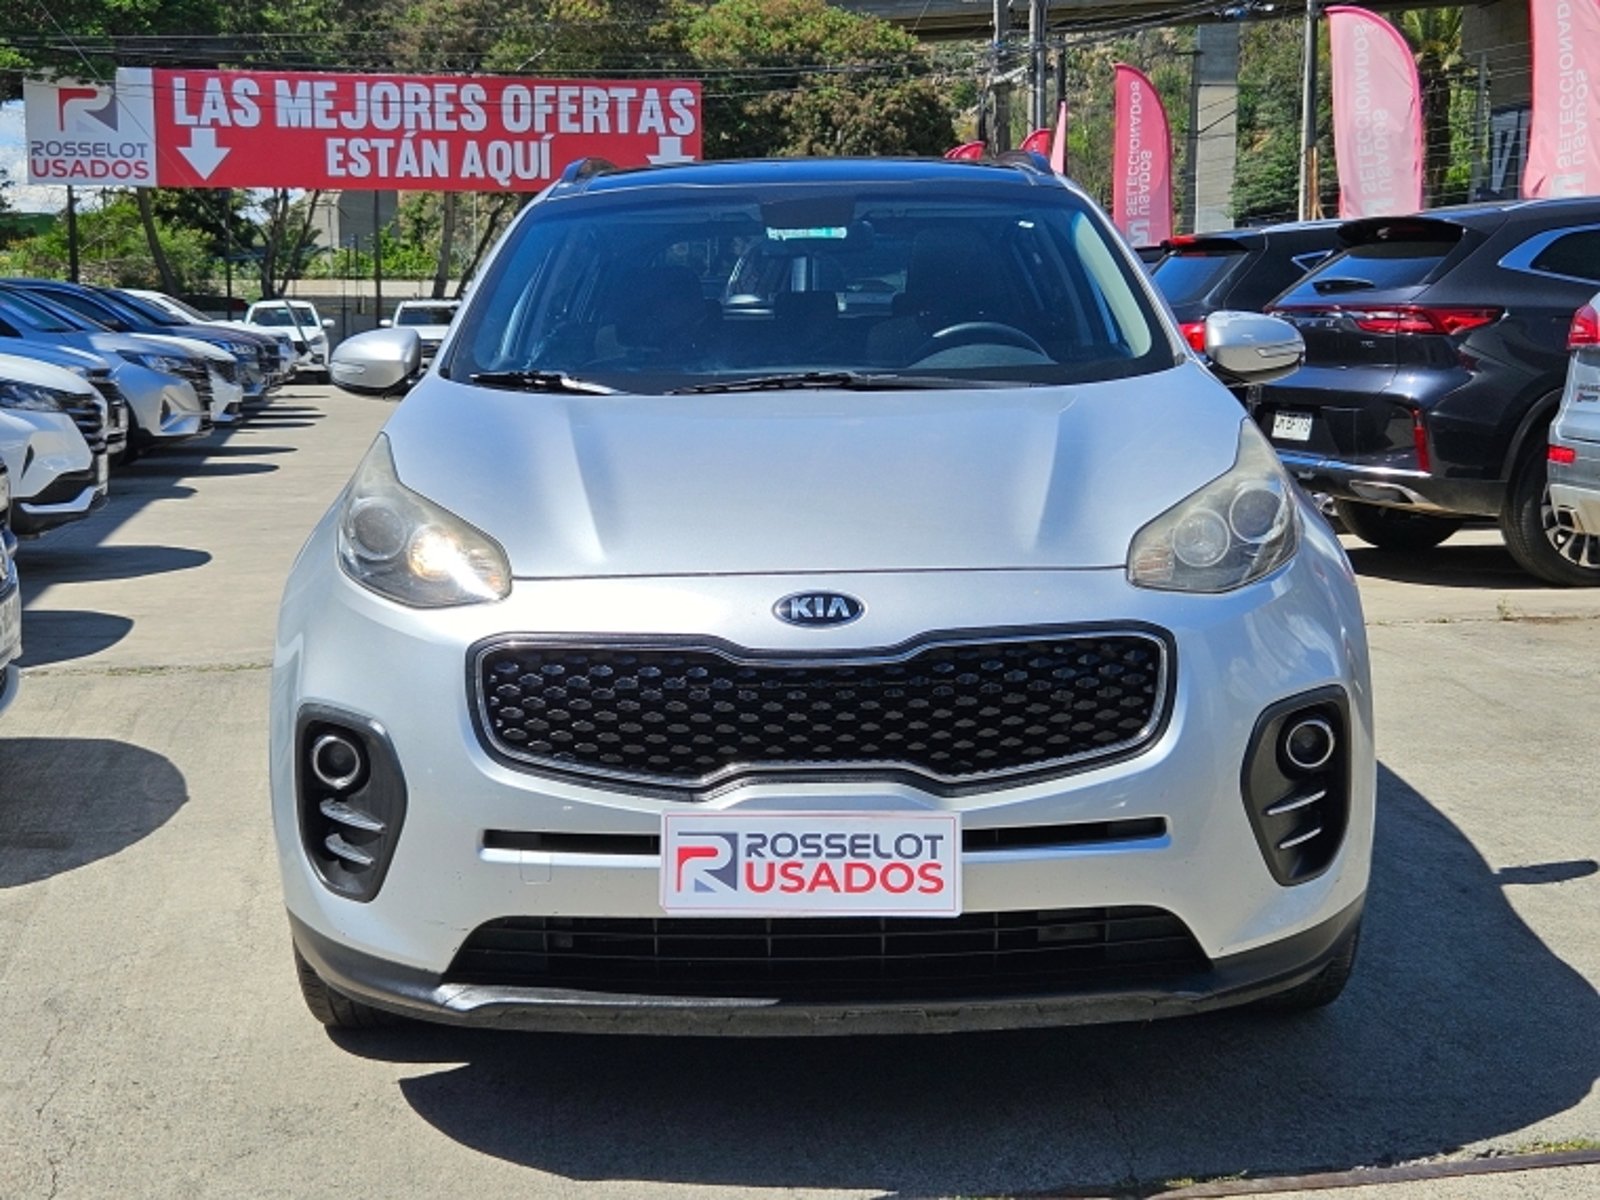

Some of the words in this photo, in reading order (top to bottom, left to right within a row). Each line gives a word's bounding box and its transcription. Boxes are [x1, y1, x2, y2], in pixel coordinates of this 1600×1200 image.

[172, 77, 261, 127] LAS
[276, 80, 487, 131] MEJORES
[502, 85, 696, 136] OFERTAS
[31, 140, 148, 158] ROSSELOT
[326, 128, 451, 178] ESTÁN
[460, 133, 553, 185] AQUÍ
[31, 159, 150, 179] USADOS
[790, 597, 850, 619] KIA
[745, 833, 944, 859] ROSSELOT
[744, 861, 945, 894] USADOS
